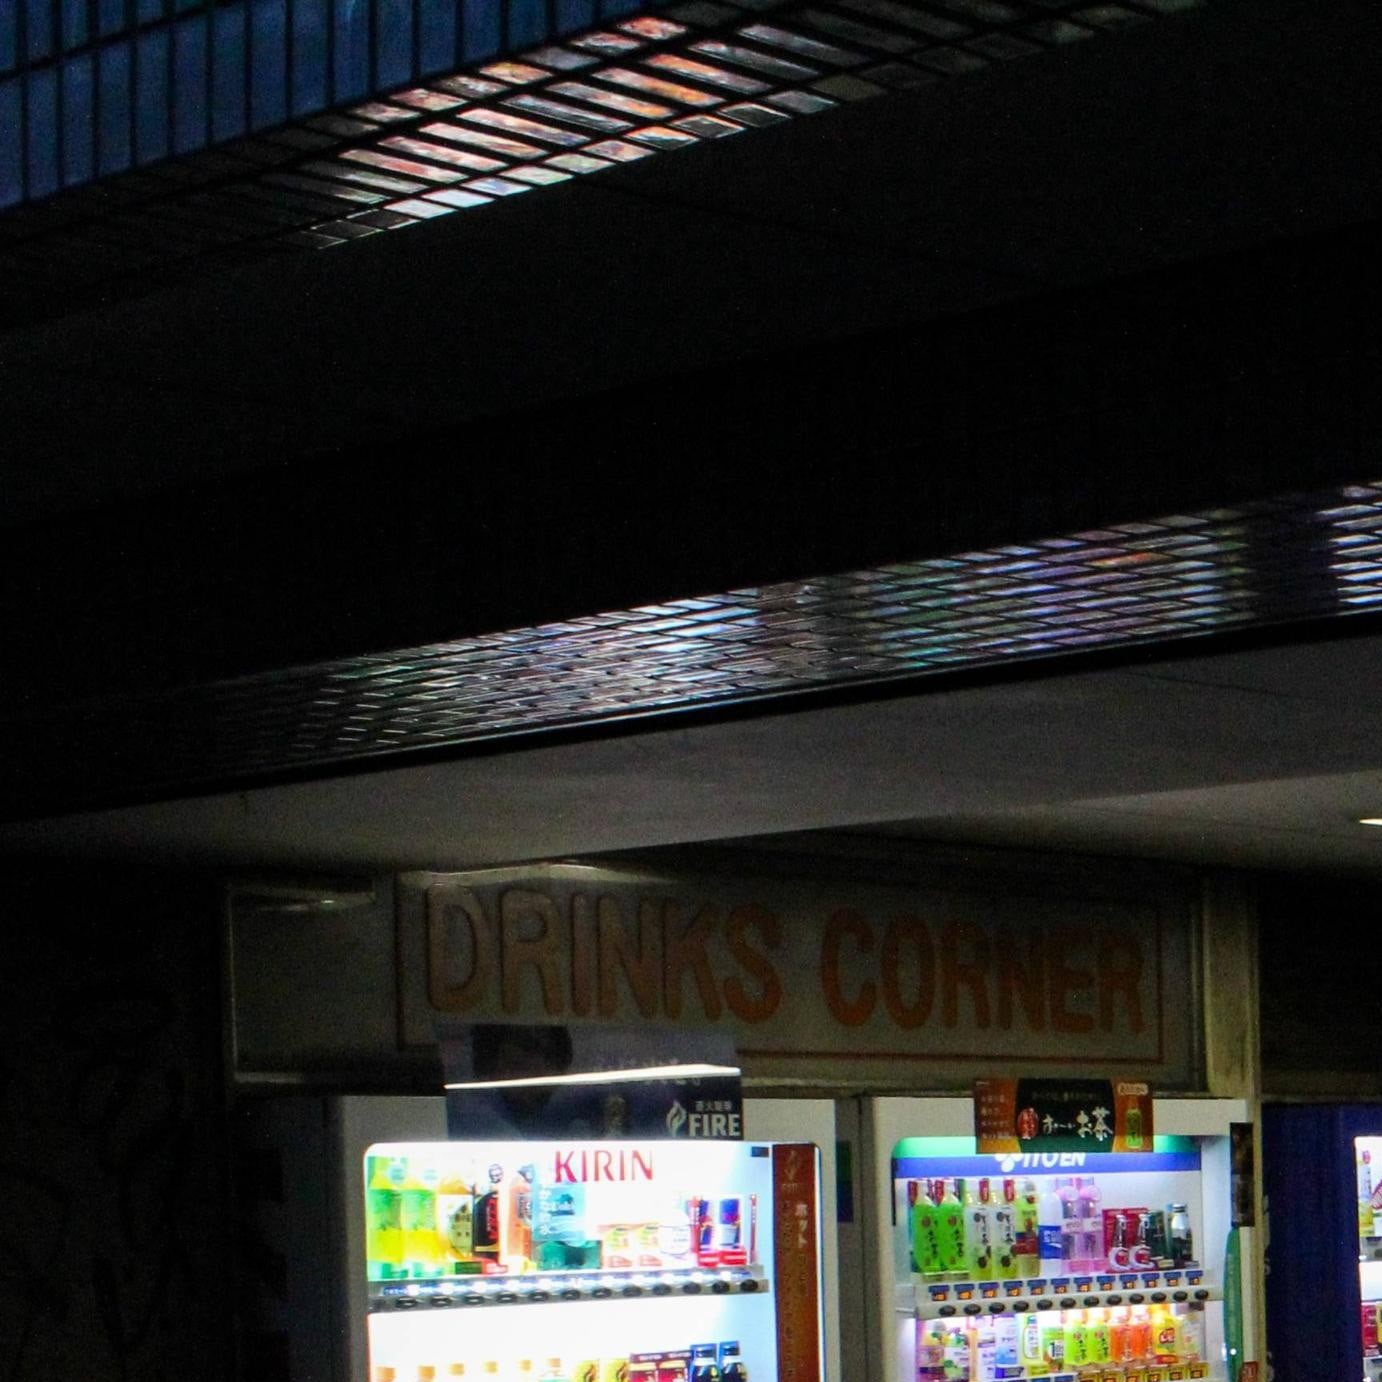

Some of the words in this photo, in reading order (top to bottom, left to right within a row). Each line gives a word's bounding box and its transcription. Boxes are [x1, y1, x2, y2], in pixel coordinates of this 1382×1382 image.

[425, 884, 783, 1025] DRINKS
[820, 908, 1145, 1033] CORNER
[687, 1113, 741, 1137] FIRE
[554, 1150, 654, 1183] KIRIN
